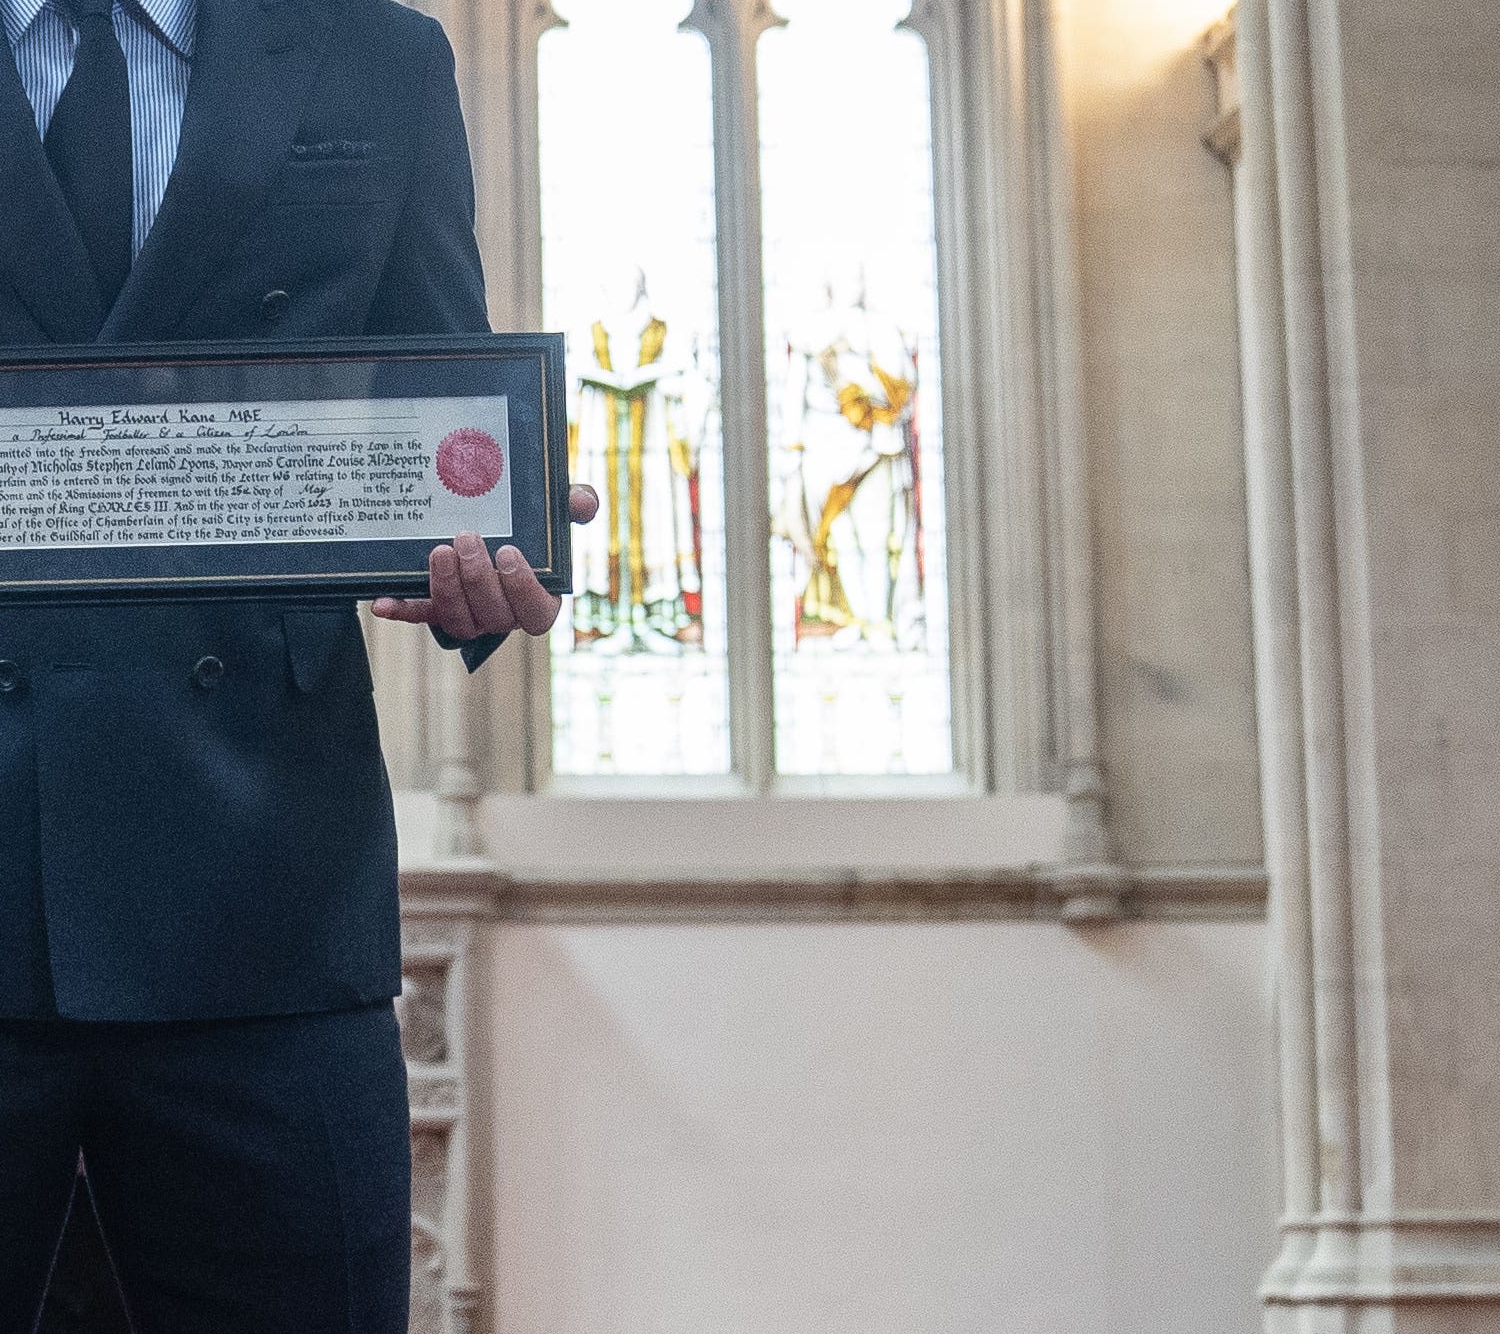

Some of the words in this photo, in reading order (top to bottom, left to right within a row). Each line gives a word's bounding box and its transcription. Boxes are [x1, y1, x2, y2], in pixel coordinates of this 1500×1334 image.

[58, 411, 104, 430] Harry
[111, 409, 168, 424] Edward
[179, 409, 215, 423] Kane
[228, 409, 262, 423] MBE
[12, 433, 19, 442] a
[30, 427, 86, 445] Professional
[101, 427, 149, 442] Footballer
[159, 426, 170, 439] &
[197, 425, 232, 437] Citizen
[244, 425, 257, 442] of
[261, 423, 308, 438] London
[36, 447, 55, 458] into
[60, 447, 74, 460] the
[80, 446, 120, 458] Freedom
[126, 444, 170, 457] aforesaid
[174, 444, 192, 454] and
[197, 443, 221, 454] made
[227, 443, 241, 455] the
[246, 442, 302, 454] Declaration
[307, 440, 346, 453] required
[351, 440, 363, 453] by
[367, 442, 389, 451] Law
[394, 439, 403, 450] in
[408, 439, 422, 452] the
[19, 462, 29, 475] of
[31, 459, 82, 475] Nicholas
[86, 458, 132, 474] Stephen
[136, 457, 176, 471] Leland
[178, 457, 218, 472] Lyons,
[222, 459, 253, 471] Mayor
[255, 457, 273, 468] and
[276, 454, 324, 468] Caroline
[327, 454, 365, 467] Louise
[30, 476, 48, 487] and
[52, 477, 60, 486] is
[64, 474, 99, 486] entered
[103, 476, 112, 485] in
[116, 474, 131, 486] the
[134, 474, 157, 484] book
[161, 473, 192, 486] signed
[195, 474, 217, 484] with
[221, 473, 236, 484] the
[239, 473, 270, 483] Letter
[295, 470, 333, 483] relating
[338, 470, 347, 480] to
[351, 470, 365, 481] the
[369, 469, 423, 483] purchasing
[26, 489, 44, 501] and
[48, 489, 62, 501] the
[65, 488, 122, 500] Admissions
[125, 487, 134, 500] of
[137, 488, 178, 500] Freemen
[182, 489, 192, 498] to
[195, 488, 211, 498] wit
[215, 487, 229, 498] the
[253, 486, 271, 498] day
[274, 485, 283, 497] of
[299, 483, 332, 498] May
[363, 484, 372, 493] in
[376, 483, 391, 494] the
[2, 504, 16, 516] the
[19, 504, 44, 516] reign
[47, 503, 57, 515] of
[59, 501, 84, 515] King
[88, 501, 151, 513] CHARLES
[174, 500, 194, 512] And
[197, 500, 207, 511] in
[210, 500, 224, 512] the
[227, 500, 249, 512] year
[251, 499, 262, 511] of
[263, 500, 280, 510] our
[283, 497, 305, 509] Lord
[308, 498, 332, 508] 2023
[339, 498, 349, 508] In
[352, 497, 391, 508] Witness
[394, 495, 432, 508] whereof
[11, 517, 22, 530] of
[26, 517, 42, 529] the
[46, 516, 78, 528] Office
[82, 516, 92, 528] of
[96, 515, 164, 527] Chamberlain
[168, 514, 178, 526] of
[182, 514, 197, 526] the
[202, 514, 223, 525] said
[227, 513, 250, 526] City
[254, 513, 263, 523] is
[267, 512, 313, 524] hereunto
[317, 510, 354, 524] affixed
[357, 511, 389, 522] Dated
[394, 511, 403, 521] in
[408, 509, 424, 521] the
[16, 531, 27, 543] of
[31, 531, 46, 543] the
[50, 529, 100, 542] Guildhall
[103, 529, 114, 542] of
[118, 529, 134, 541] the
[138, 531, 164, 540] same
[168, 529, 191, 540] City
[195, 529, 211, 540] the
[214, 527, 237, 540] Day
[241, 527, 260, 538] and
[263, 527, 288, 538] Year
[292, 525, 347, 537] abovesaid.
